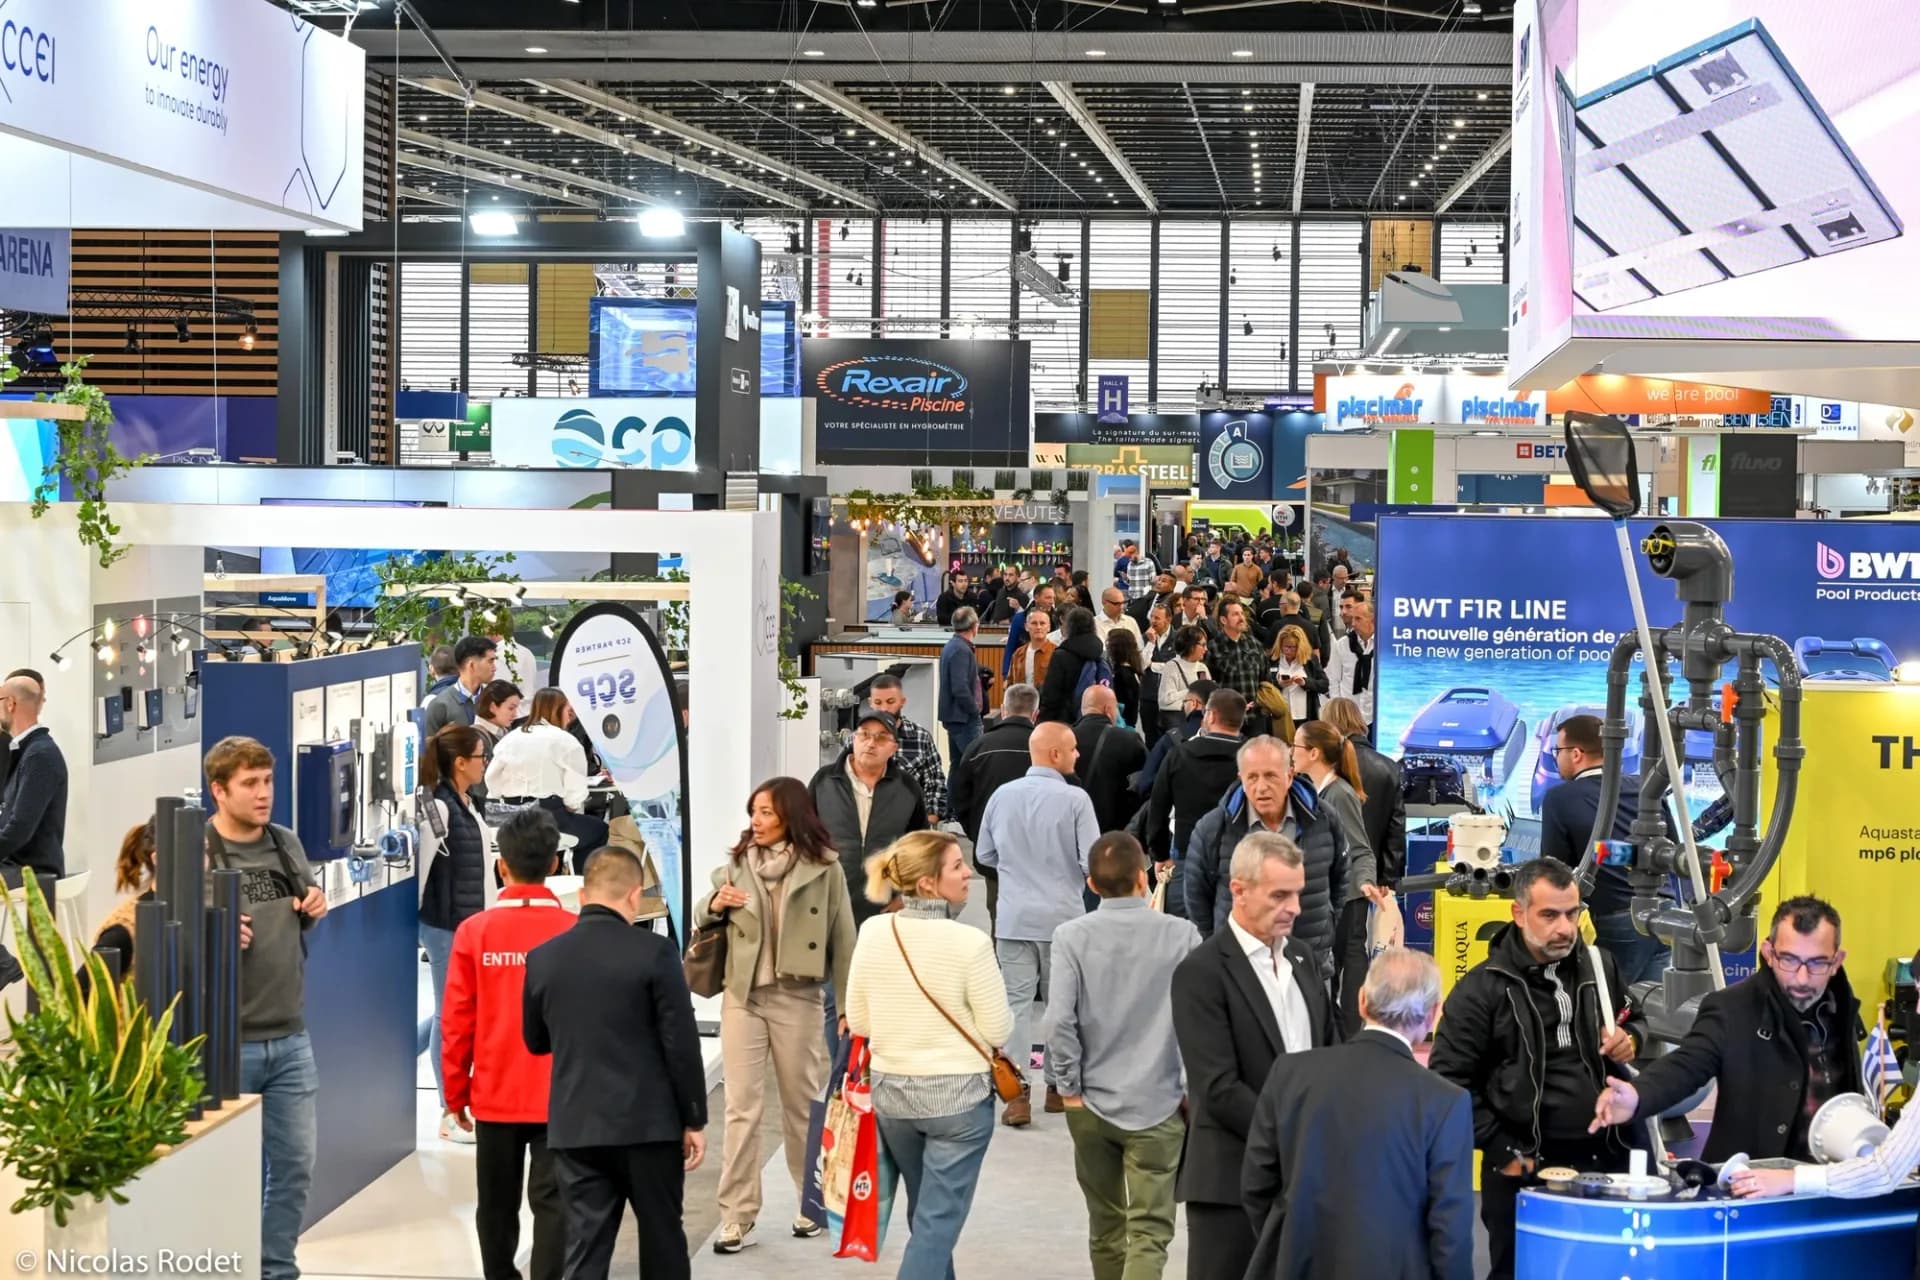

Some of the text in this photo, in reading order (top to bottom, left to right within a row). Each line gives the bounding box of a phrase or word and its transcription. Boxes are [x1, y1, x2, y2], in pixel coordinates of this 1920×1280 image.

[146, 25, 229, 104] Our energy
[145, 82, 229, 136] to innovate durably
[841, 369, 953, 394] Rexair
[909, 396, 966, 412] Piscine
[1104, 389, 1122, 411] H
[1646, 388, 1739, 403] we are pool
[1337, 395, 1423, 424] piscimar
[1462, 395, 1540, 424] piscimar
[1822, 404, 1840, 417] DS
[850, 421, 897, 430] SPÉCIALISTE
[911, 421, 964, 431] HYGROMÉTRIE
[1105, 430, 1146, 438] signature
[1233, 427, 1242, 437] A
[1816, 588, 1850, 600] Pool
[1393, 598, 1567, 620] BWT F1R LINE
[1392, 627, 1413, 640] La
[1416, 627, 1490, 642] nouvelle
[1492, 628, 1588, 646] génération
[1592, 629, 1615, 643] de
[1392, 643, 1415, 657] The
[1418, 646, 1460, 658] new
[1463, 645, 1551, 662] generation
[1556, 646, 1576, 660] of
[1859, 847, 1896, 862] mp6
[247, 870, 270, 882] THE
[247, 889, 277, 904] FACE
[1455, 920, 1470, 981] RAQUA
